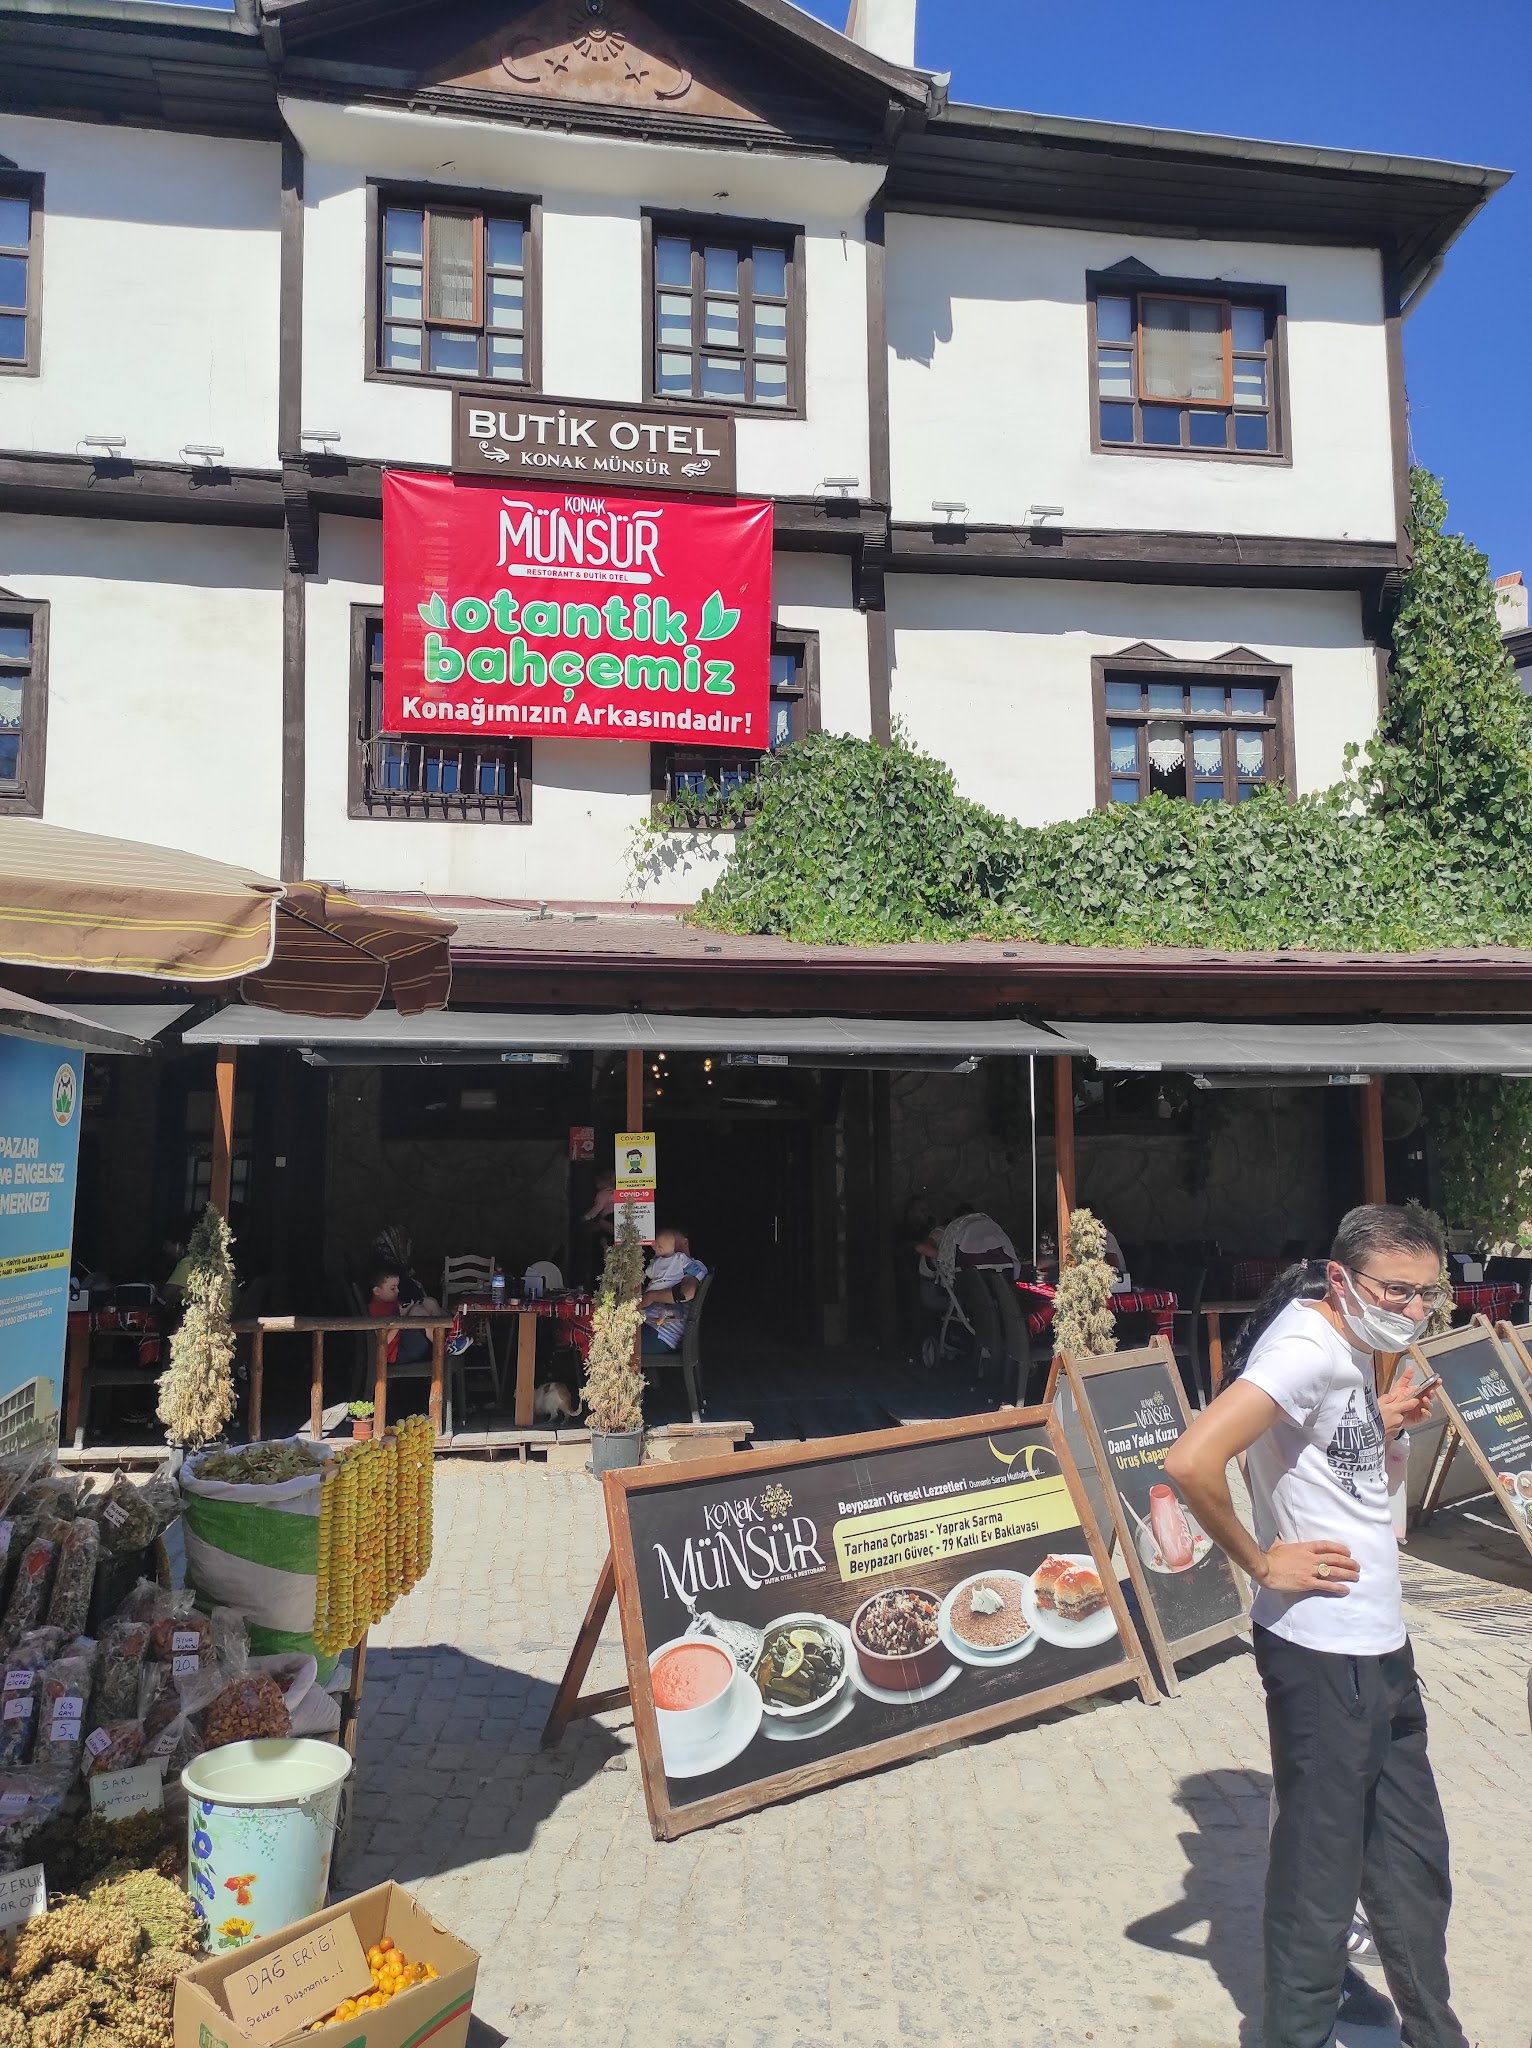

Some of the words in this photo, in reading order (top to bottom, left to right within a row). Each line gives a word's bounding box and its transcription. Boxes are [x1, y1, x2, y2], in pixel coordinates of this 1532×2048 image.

[468, 409, 598, 448] BUTİK
[609, 421, 721, 457] OTEL
[521, 451, 588, 470] KONAK
[593, 455, 671, 476] MÜNSÜR
[565, 496, 606, 516] KONAK
[496, 496, 665, 577] MÜNSÜR
[527, 568, 573, 578] RESTORANT
[584, 570, 607, 580] BUTİK
[609, 573, 629, 581] OTEL
[451, 588, 687, 647] otantik
[424, 632, 735, 703] bahçemiz
[402, 697, 567, 726] Konağımızın
[574, 703, 753, 734] Arkasındadır!
[1108, 1440, 1131, 1454] Dana
[1132, 1432, 1155, 1448] Yada
[1155, 1428, 1178, 1443] Kuzu
[1116, 1455, 1140, 1470] Uruş
[838, 1497, 886, 1515] Beypazarı
[886, 1486, 922, 1504] Yöresel
[923, 1478, 968, 1497] Lezzetleri
[844, 1536, 889, 1557] Tarhana
[890, 1528, 928, 1547] Çorbası
[936, 1518, 970, 1536] Yaprak
[972, 1512, 1003, 1527] Sarma
[850, 1551, 902, 1574] Beypazarı
[904, 1543, 934, 1561] Güveç
[942, 1538, 954, 1552] 79
[956, 1532, 979, 1549] Katlı
[981, 1531, 992, 1544] Ev
[994, 1521, 1039, 1539] Baklavası
[175, 1659, 190, 1672] 20
[58, 1723, 71, 1737] 5
[102, 1774, 135, 1791] SARI
[19, 1893, 43, 1908] OTU
[245, 1954, 285, 1996] DAĞ
[292, 1928, 337, 1967] ERİĞİ
